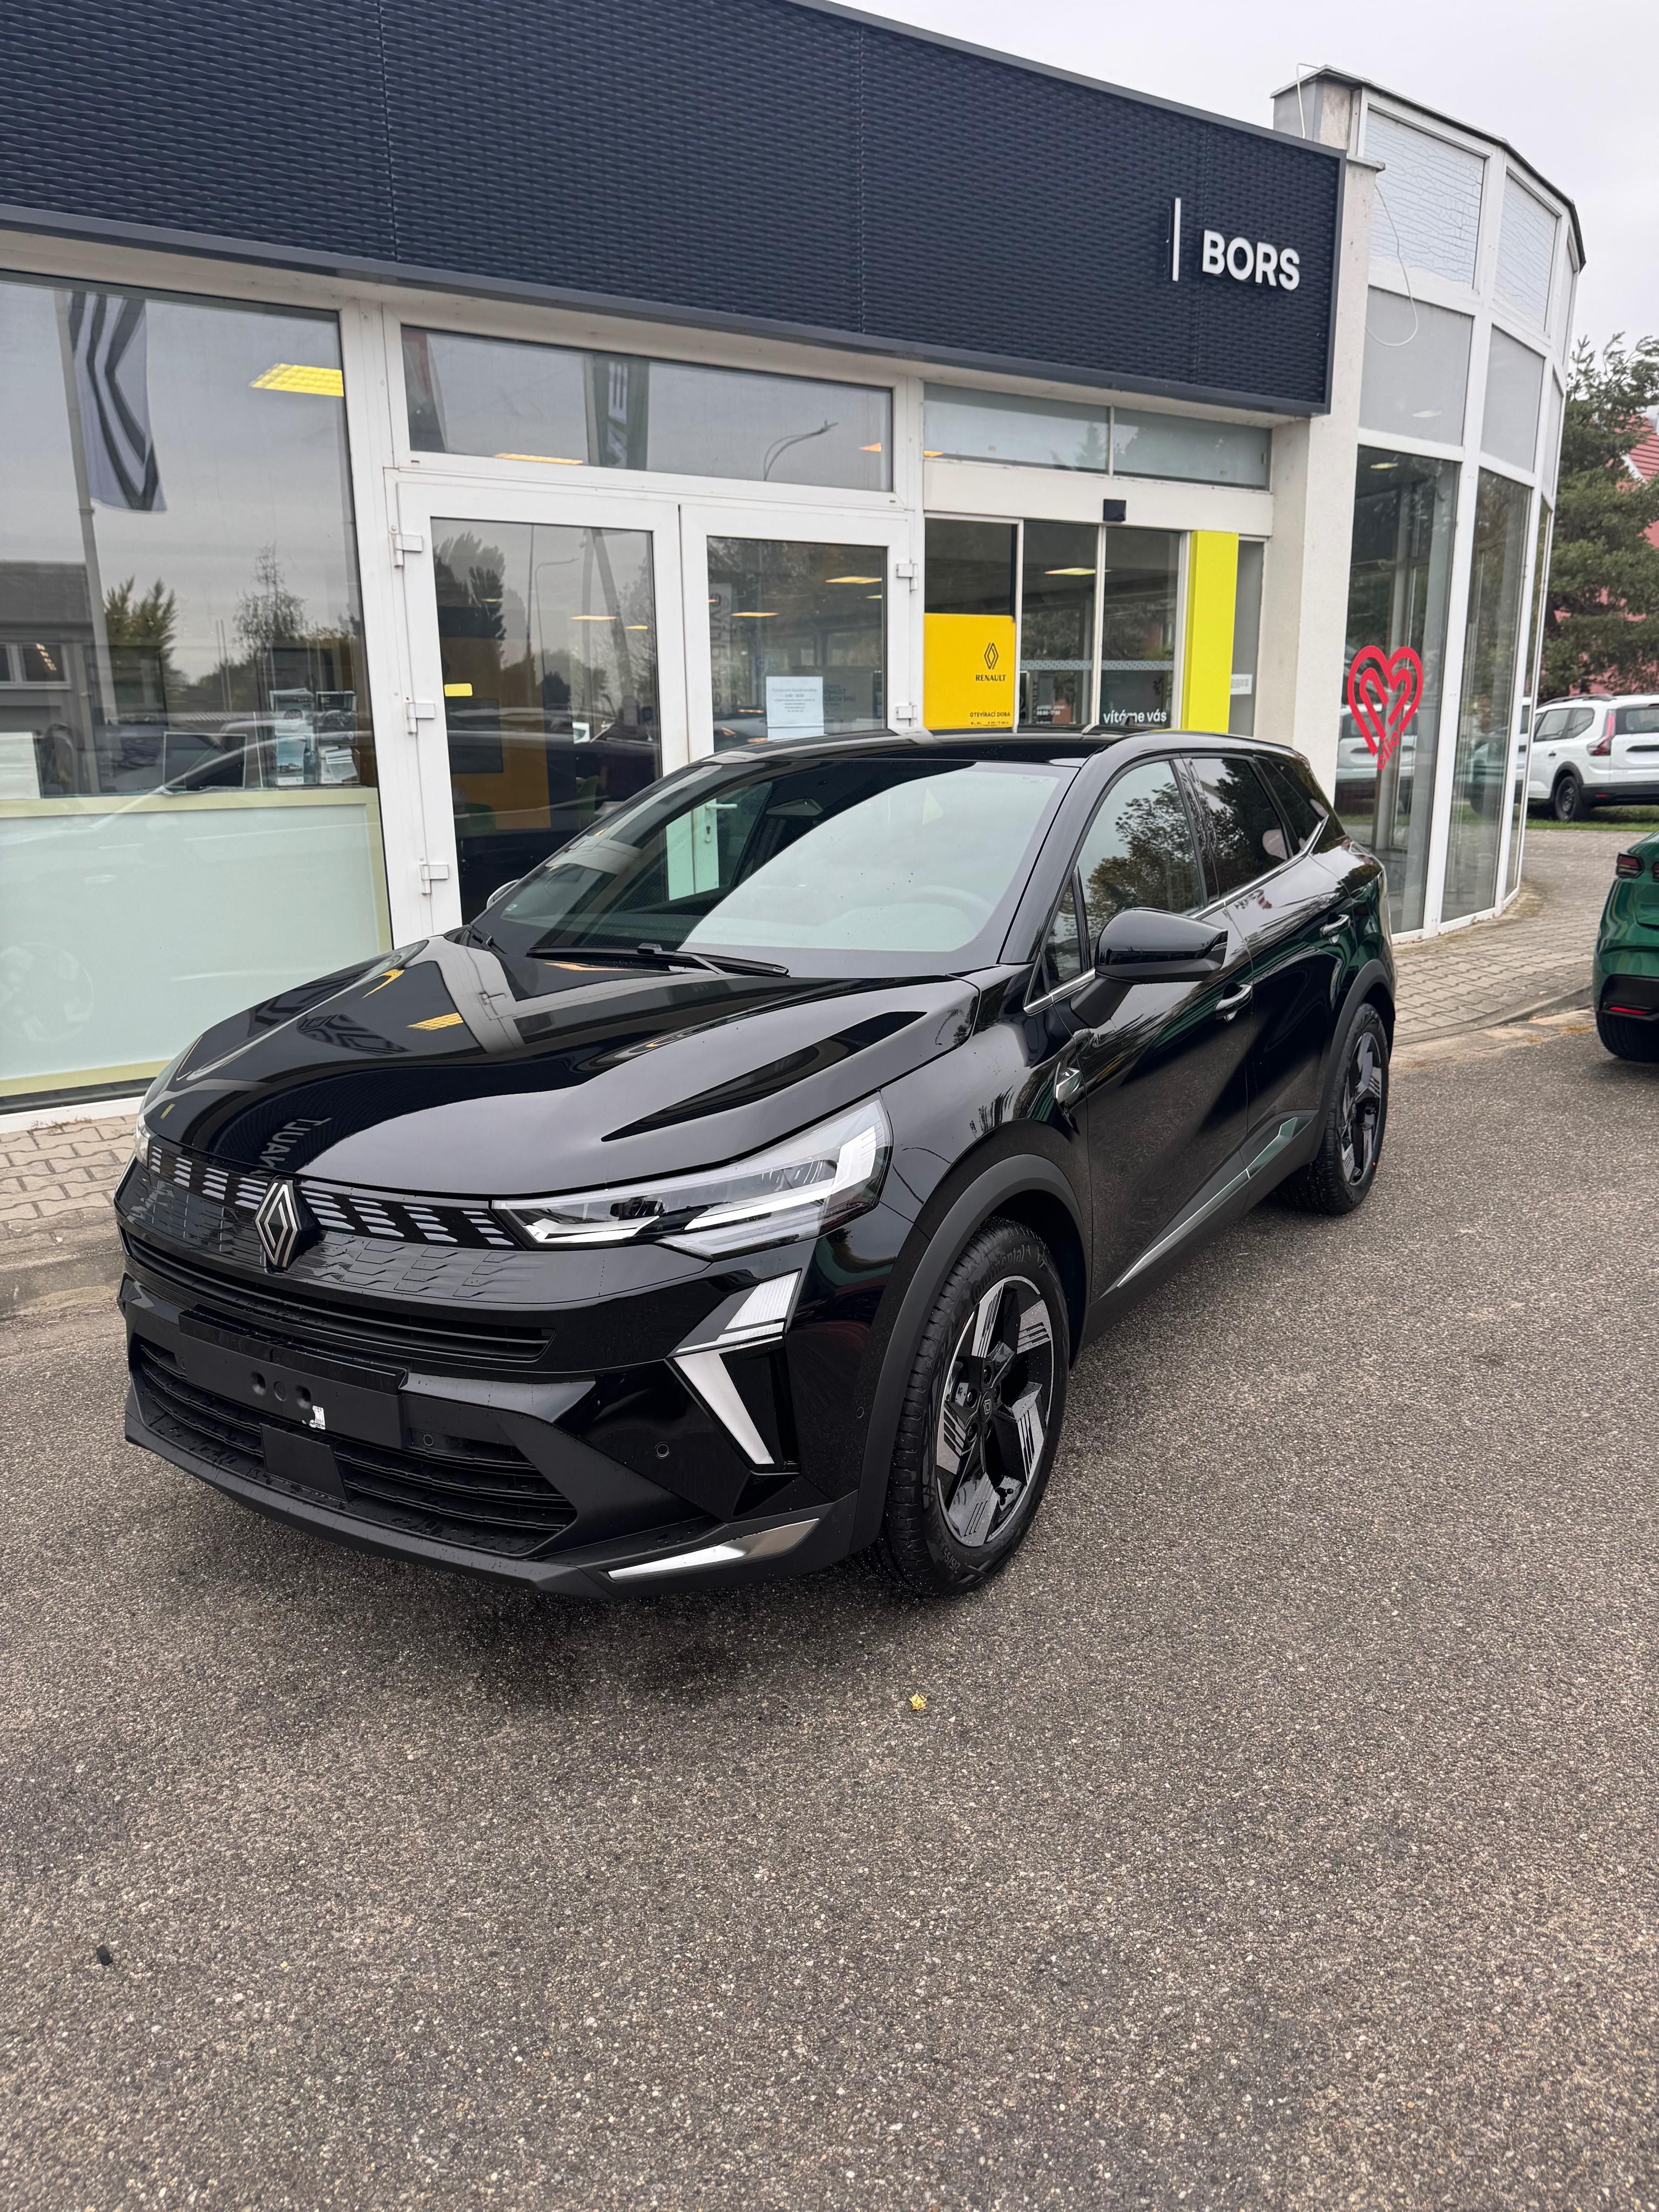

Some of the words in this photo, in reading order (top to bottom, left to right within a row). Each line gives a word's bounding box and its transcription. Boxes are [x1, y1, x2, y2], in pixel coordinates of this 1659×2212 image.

[1203, 230, 1300, 291] BORS
[1147, 709, 1167, 722] vás
[1377, 731, 1400, 771] clio
[972, 1245, 1024, 1301] Continental
[943, 1547, 961, 1574] 215/55
